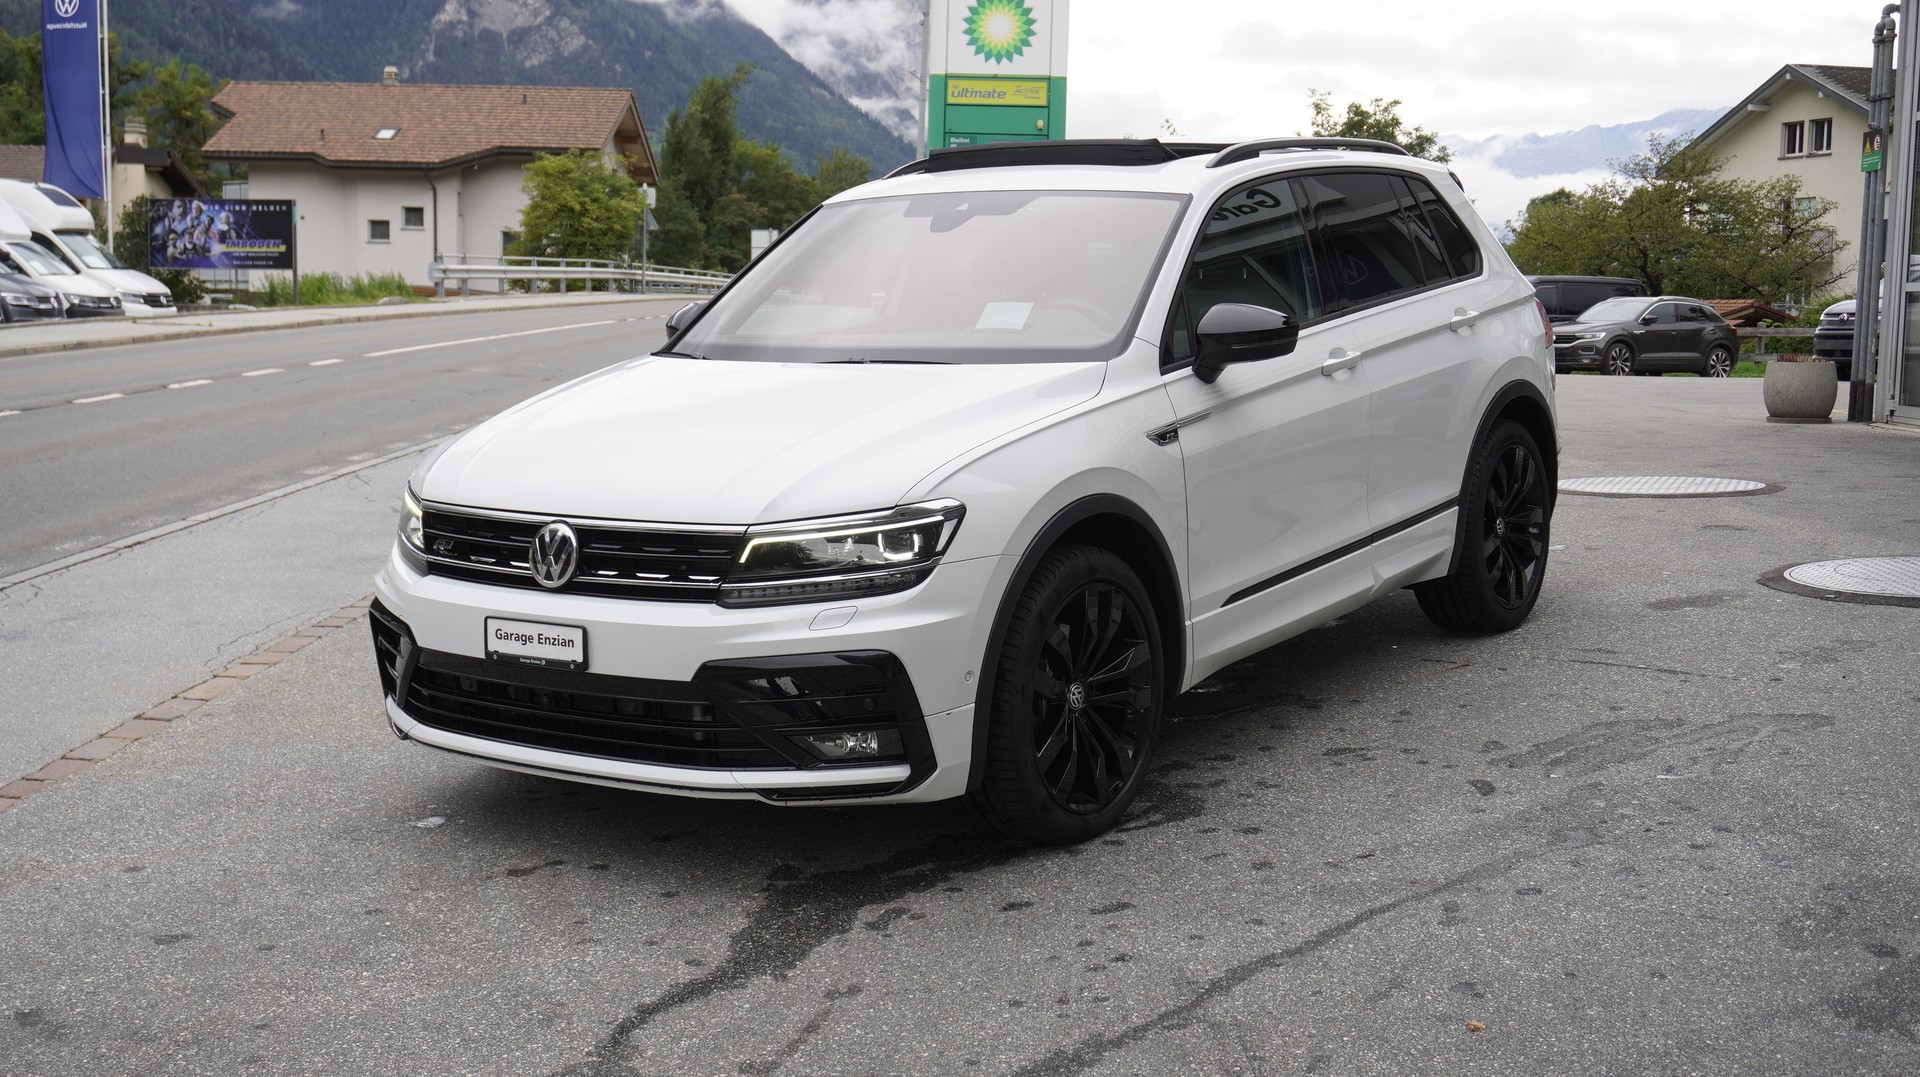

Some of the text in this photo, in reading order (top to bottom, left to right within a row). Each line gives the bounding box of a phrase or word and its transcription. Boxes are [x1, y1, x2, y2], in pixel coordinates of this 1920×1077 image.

[951, 88, 1007, 99] ultimate
[225, 239, 283, 249] IMBODEN
[495, 628, 575, 648] Garage Enzian
